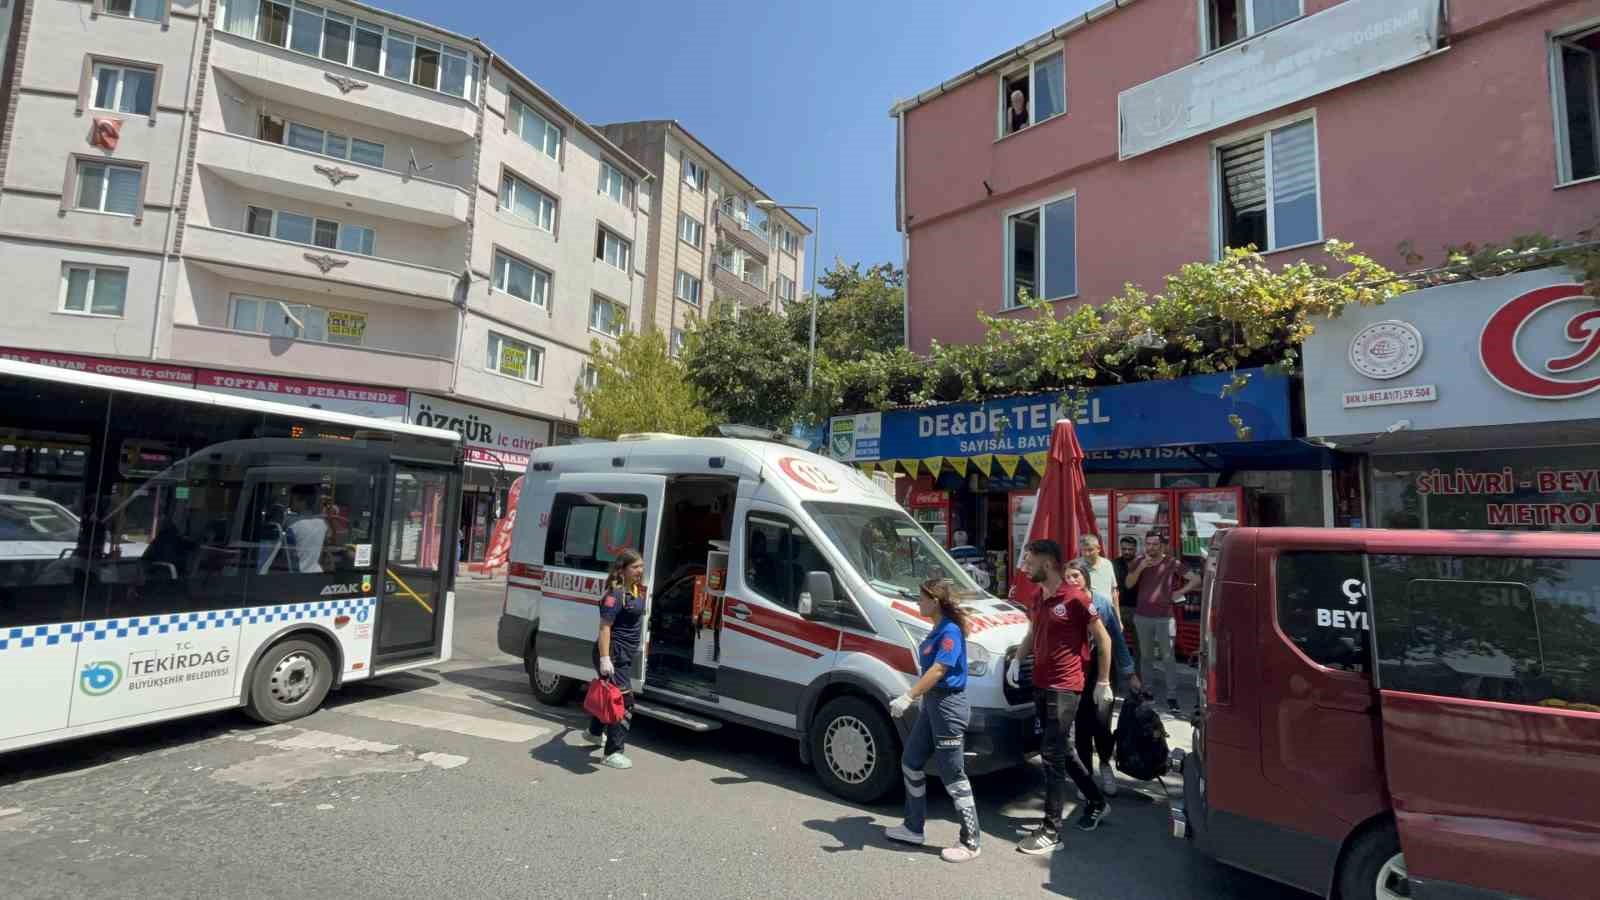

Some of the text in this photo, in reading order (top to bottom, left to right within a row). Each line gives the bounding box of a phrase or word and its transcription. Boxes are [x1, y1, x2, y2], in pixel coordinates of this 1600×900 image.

[213, 376, 396, 403] TOPTAN ve PERAKENDE
[416, 404, 492, 443] ÖZGÜR
[960, 439, 1013, 453] SAYISAL
[1416, 466, 1514, 495] SİLİVRİ
[320, 583, 359, 595] ATAK
[543, 573, 608, 597] AMBULA
[1342, 578, 1366, 605] Ç
[132, 646, 231, 675] TEKİRDAĞ
